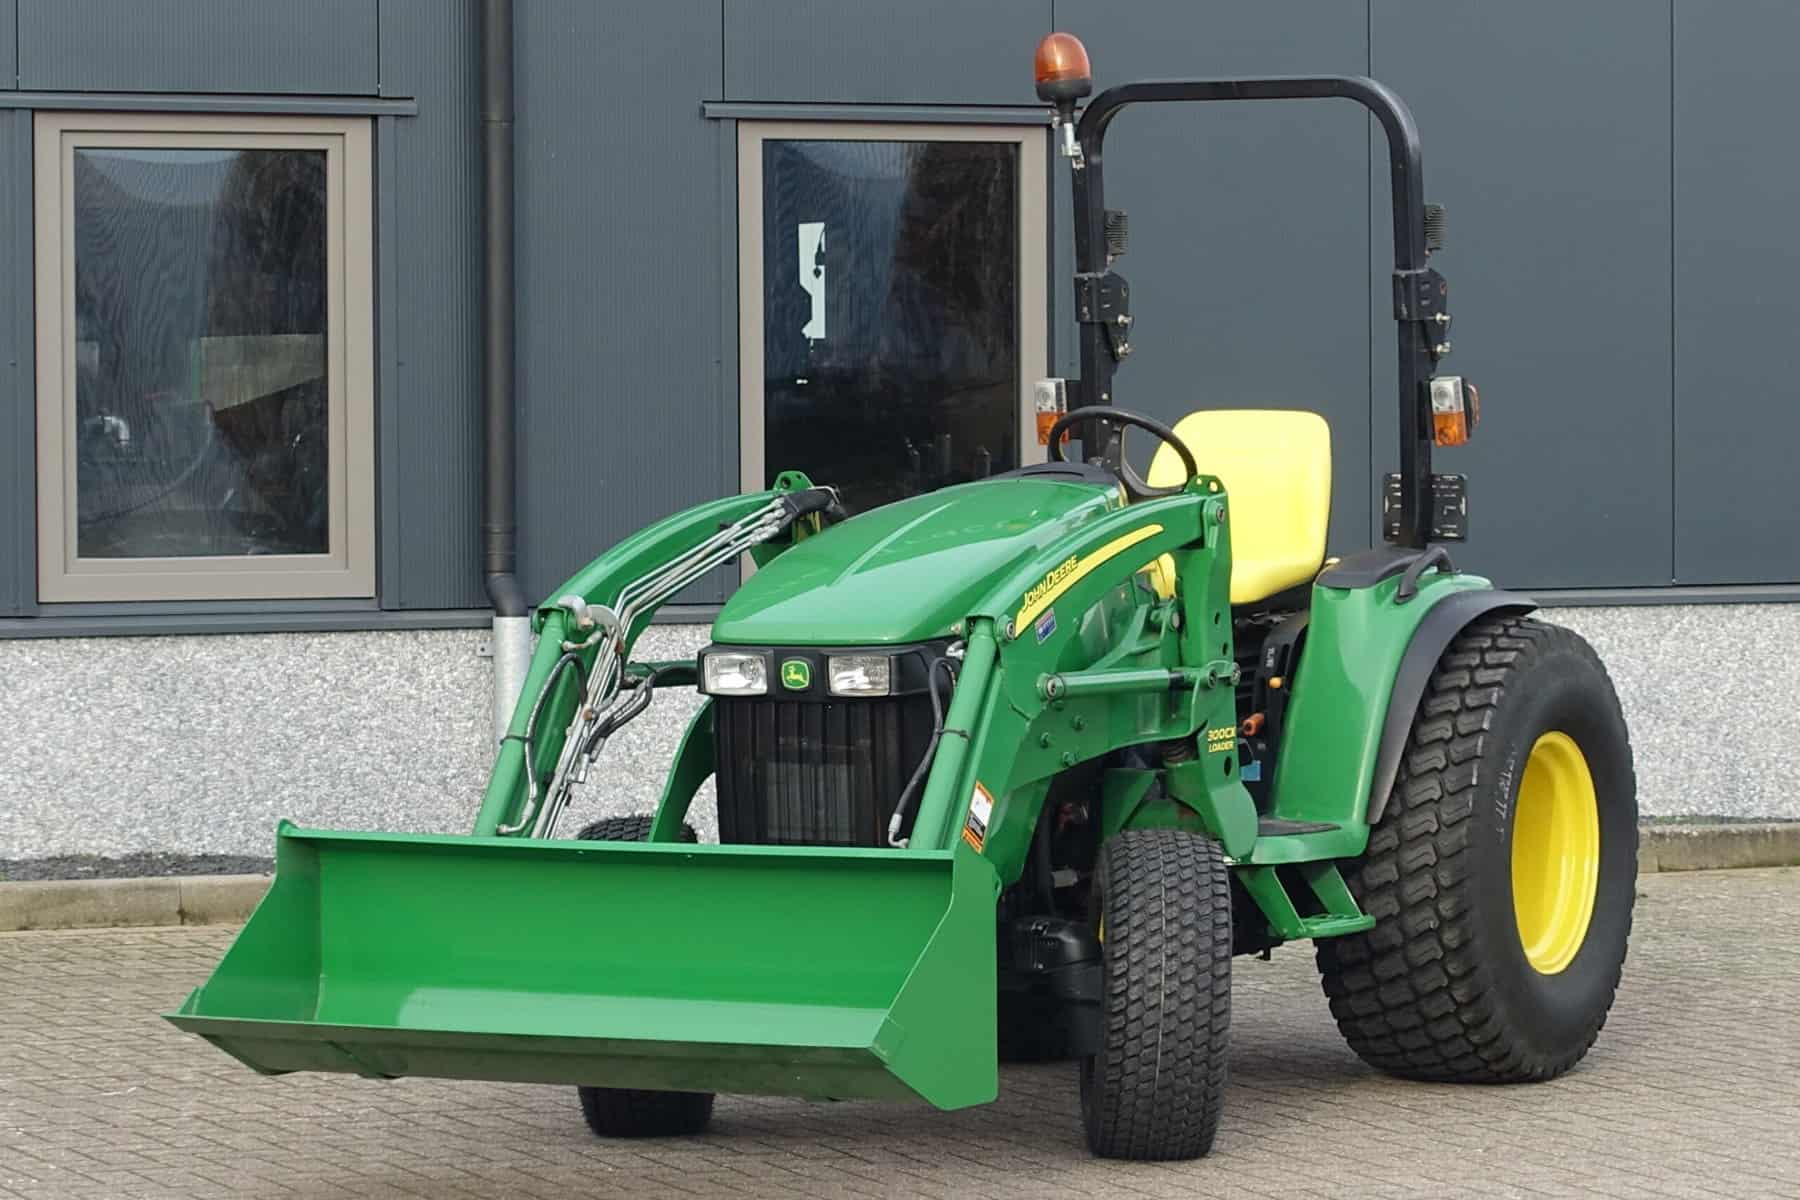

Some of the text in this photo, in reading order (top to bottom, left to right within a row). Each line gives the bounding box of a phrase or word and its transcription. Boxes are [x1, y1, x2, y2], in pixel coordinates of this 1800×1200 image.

[1022, 554, 1078, 612] JOHN DEERE
[1208, 741, 1234, 753] LOADER
